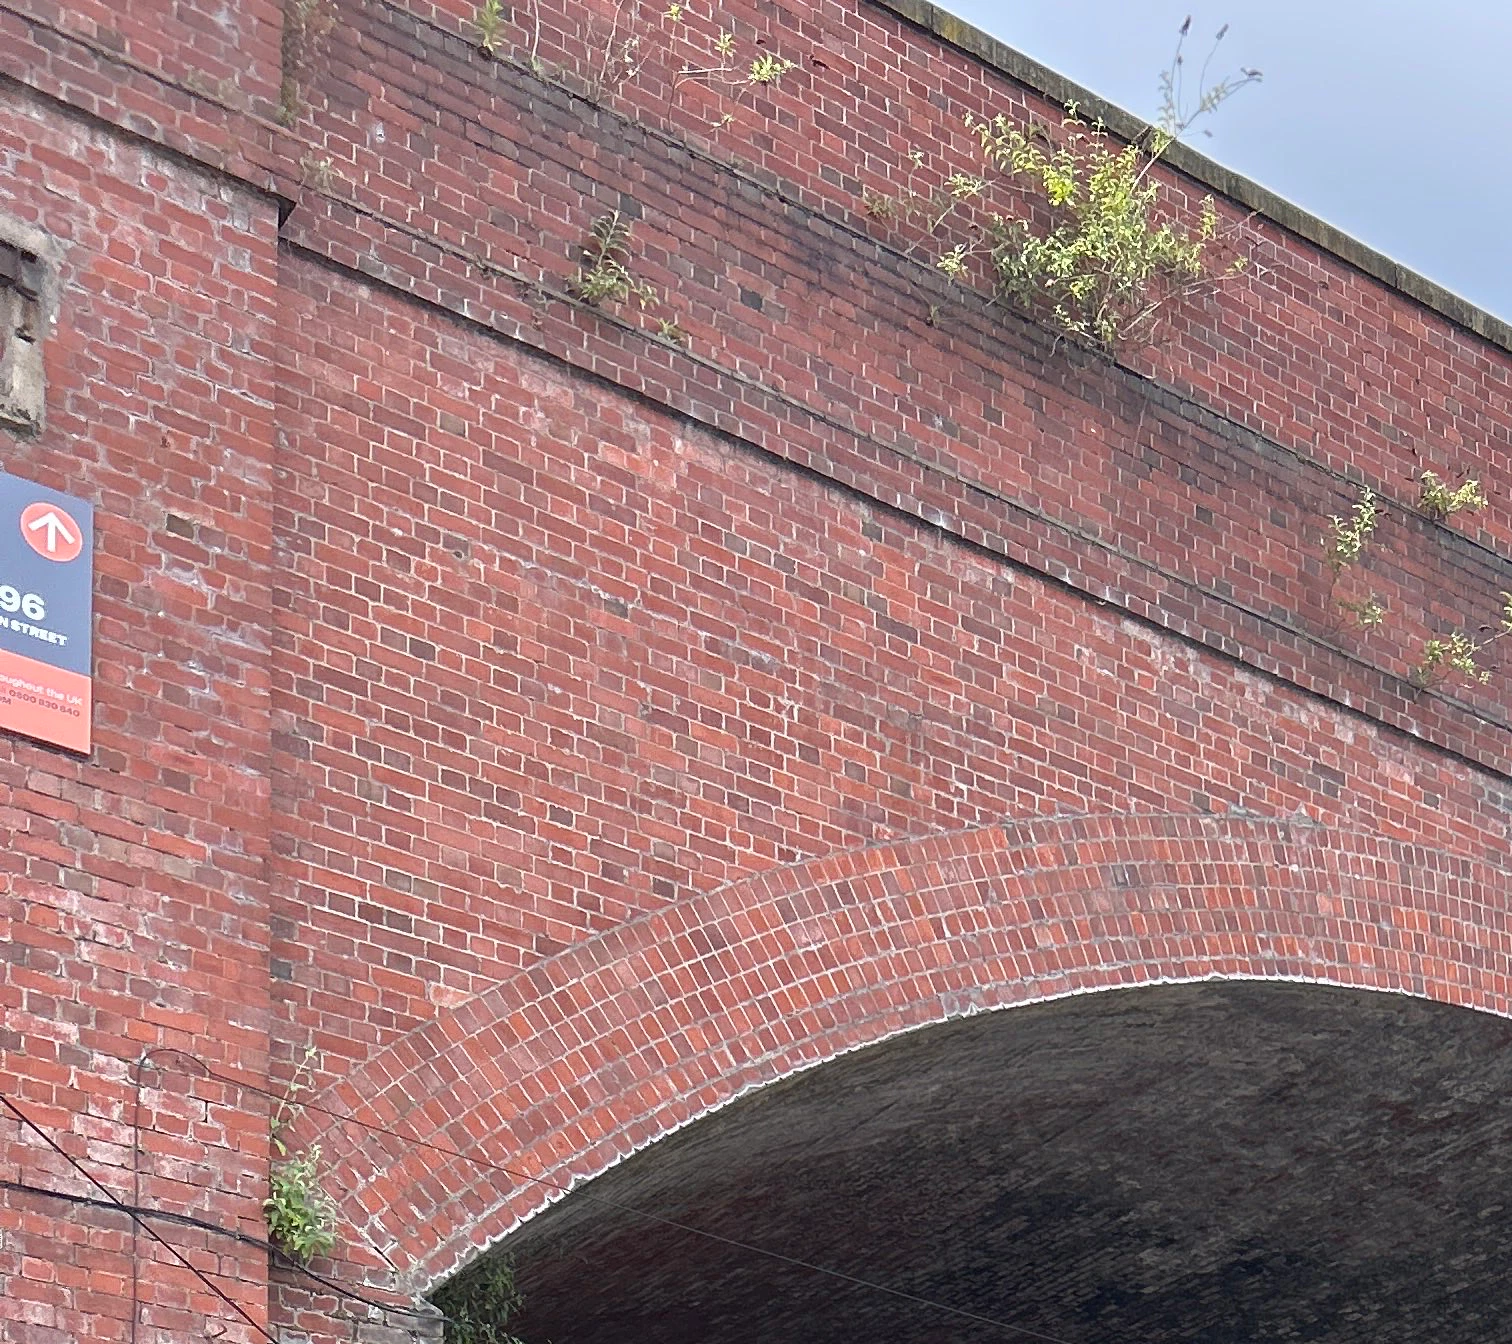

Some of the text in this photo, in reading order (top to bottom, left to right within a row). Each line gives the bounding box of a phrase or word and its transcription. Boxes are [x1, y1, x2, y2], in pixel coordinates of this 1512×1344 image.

[0, 585, 45, 621] 96
[10, 619, 68, 646] STREET
[66, 694, 83, 706] UK
